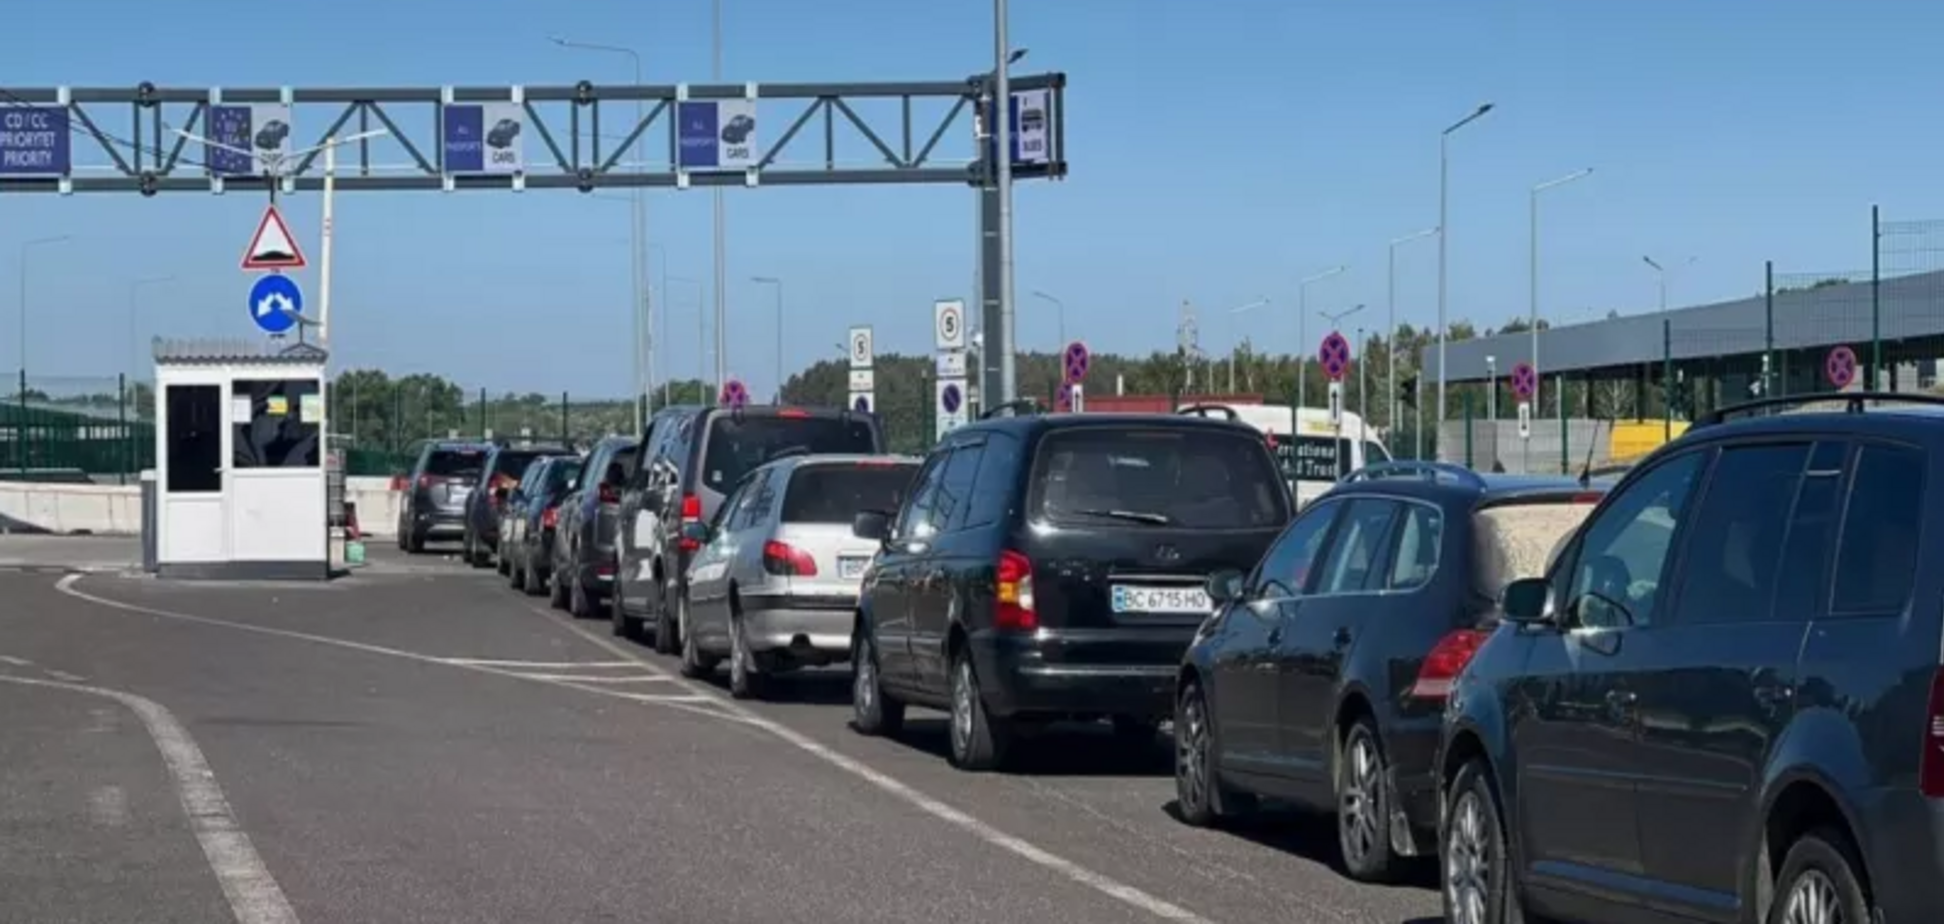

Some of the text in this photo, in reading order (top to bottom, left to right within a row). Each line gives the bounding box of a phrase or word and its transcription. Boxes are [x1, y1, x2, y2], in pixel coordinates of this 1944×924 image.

[5, 112, 22, 128] CD
[31, 112, 49, 128] CC
[4, 150, 52, 166] PRIORITY
[492, 150, 515, 163] CARS
[726, 147, 749, 159] CARS
[945, 315, 955, 333] 5
[857, 340, 865, 355] 5
[1124, 591, 1144, 608] BC
[1148, 591, 1182, 608] 6715
